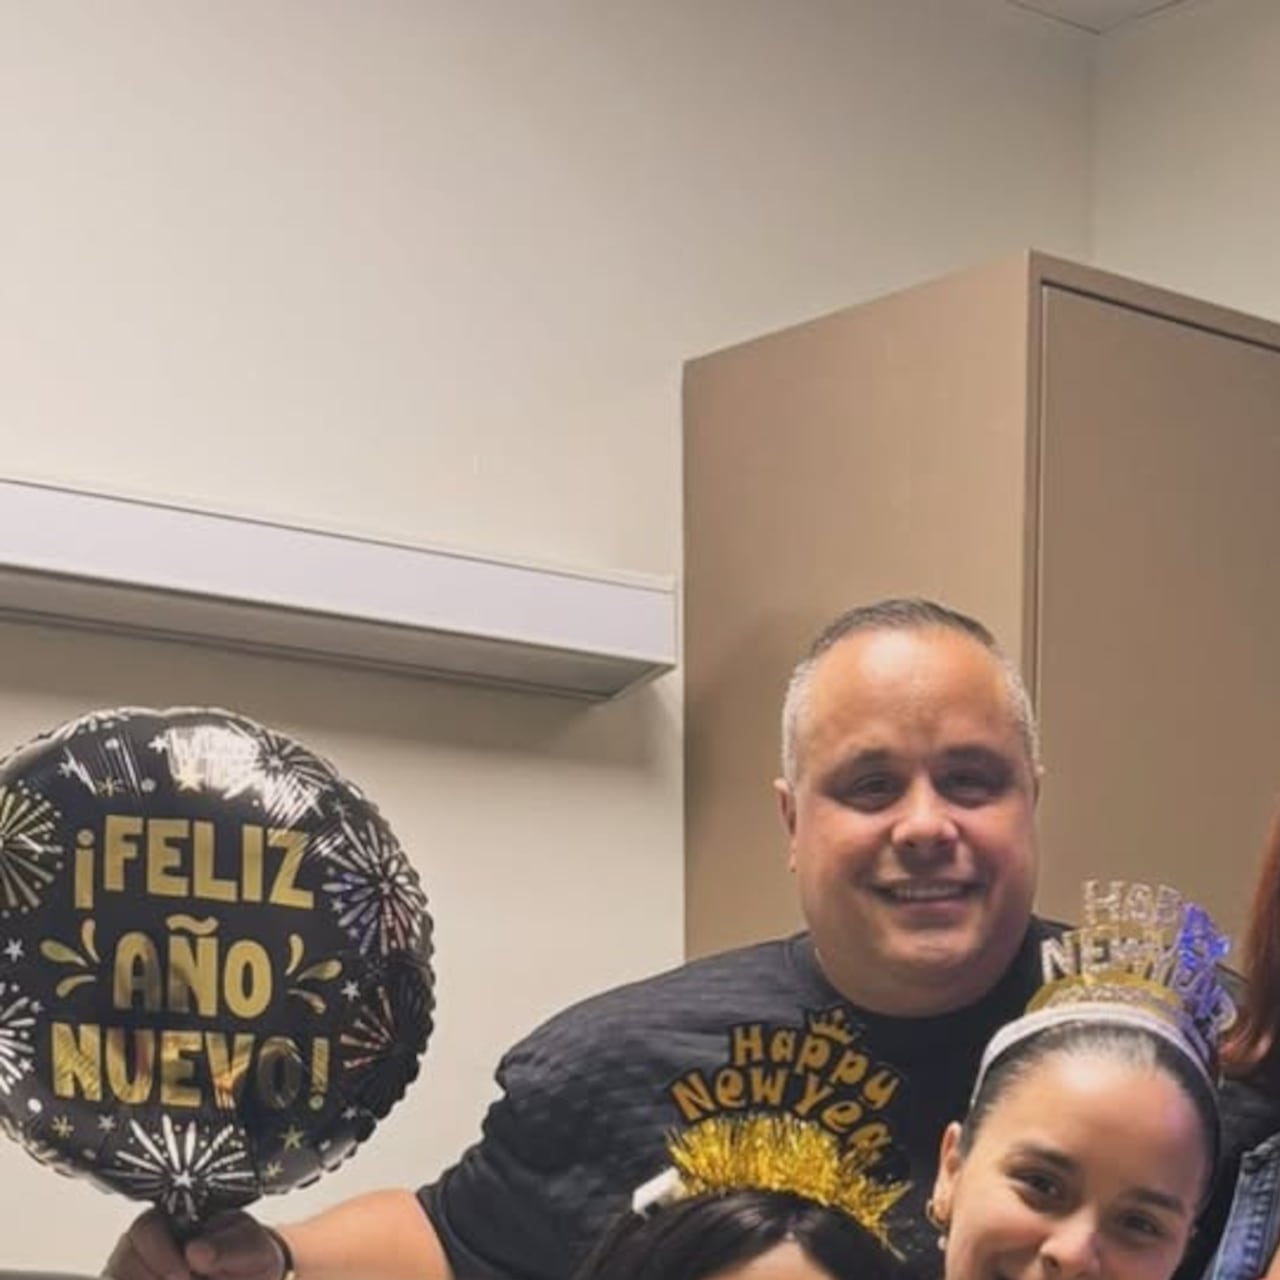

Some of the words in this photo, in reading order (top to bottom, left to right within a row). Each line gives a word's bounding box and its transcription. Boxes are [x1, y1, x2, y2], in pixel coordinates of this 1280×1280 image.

[74, 815, 315, 909] ¡FELIZ
[113, 914, 273, 1020] AÑO
[50, 1022, 331, 1110] NUEVO!
[671, 1070, 788, 1121] New
[731, 1022, 900, 1110] Happy
